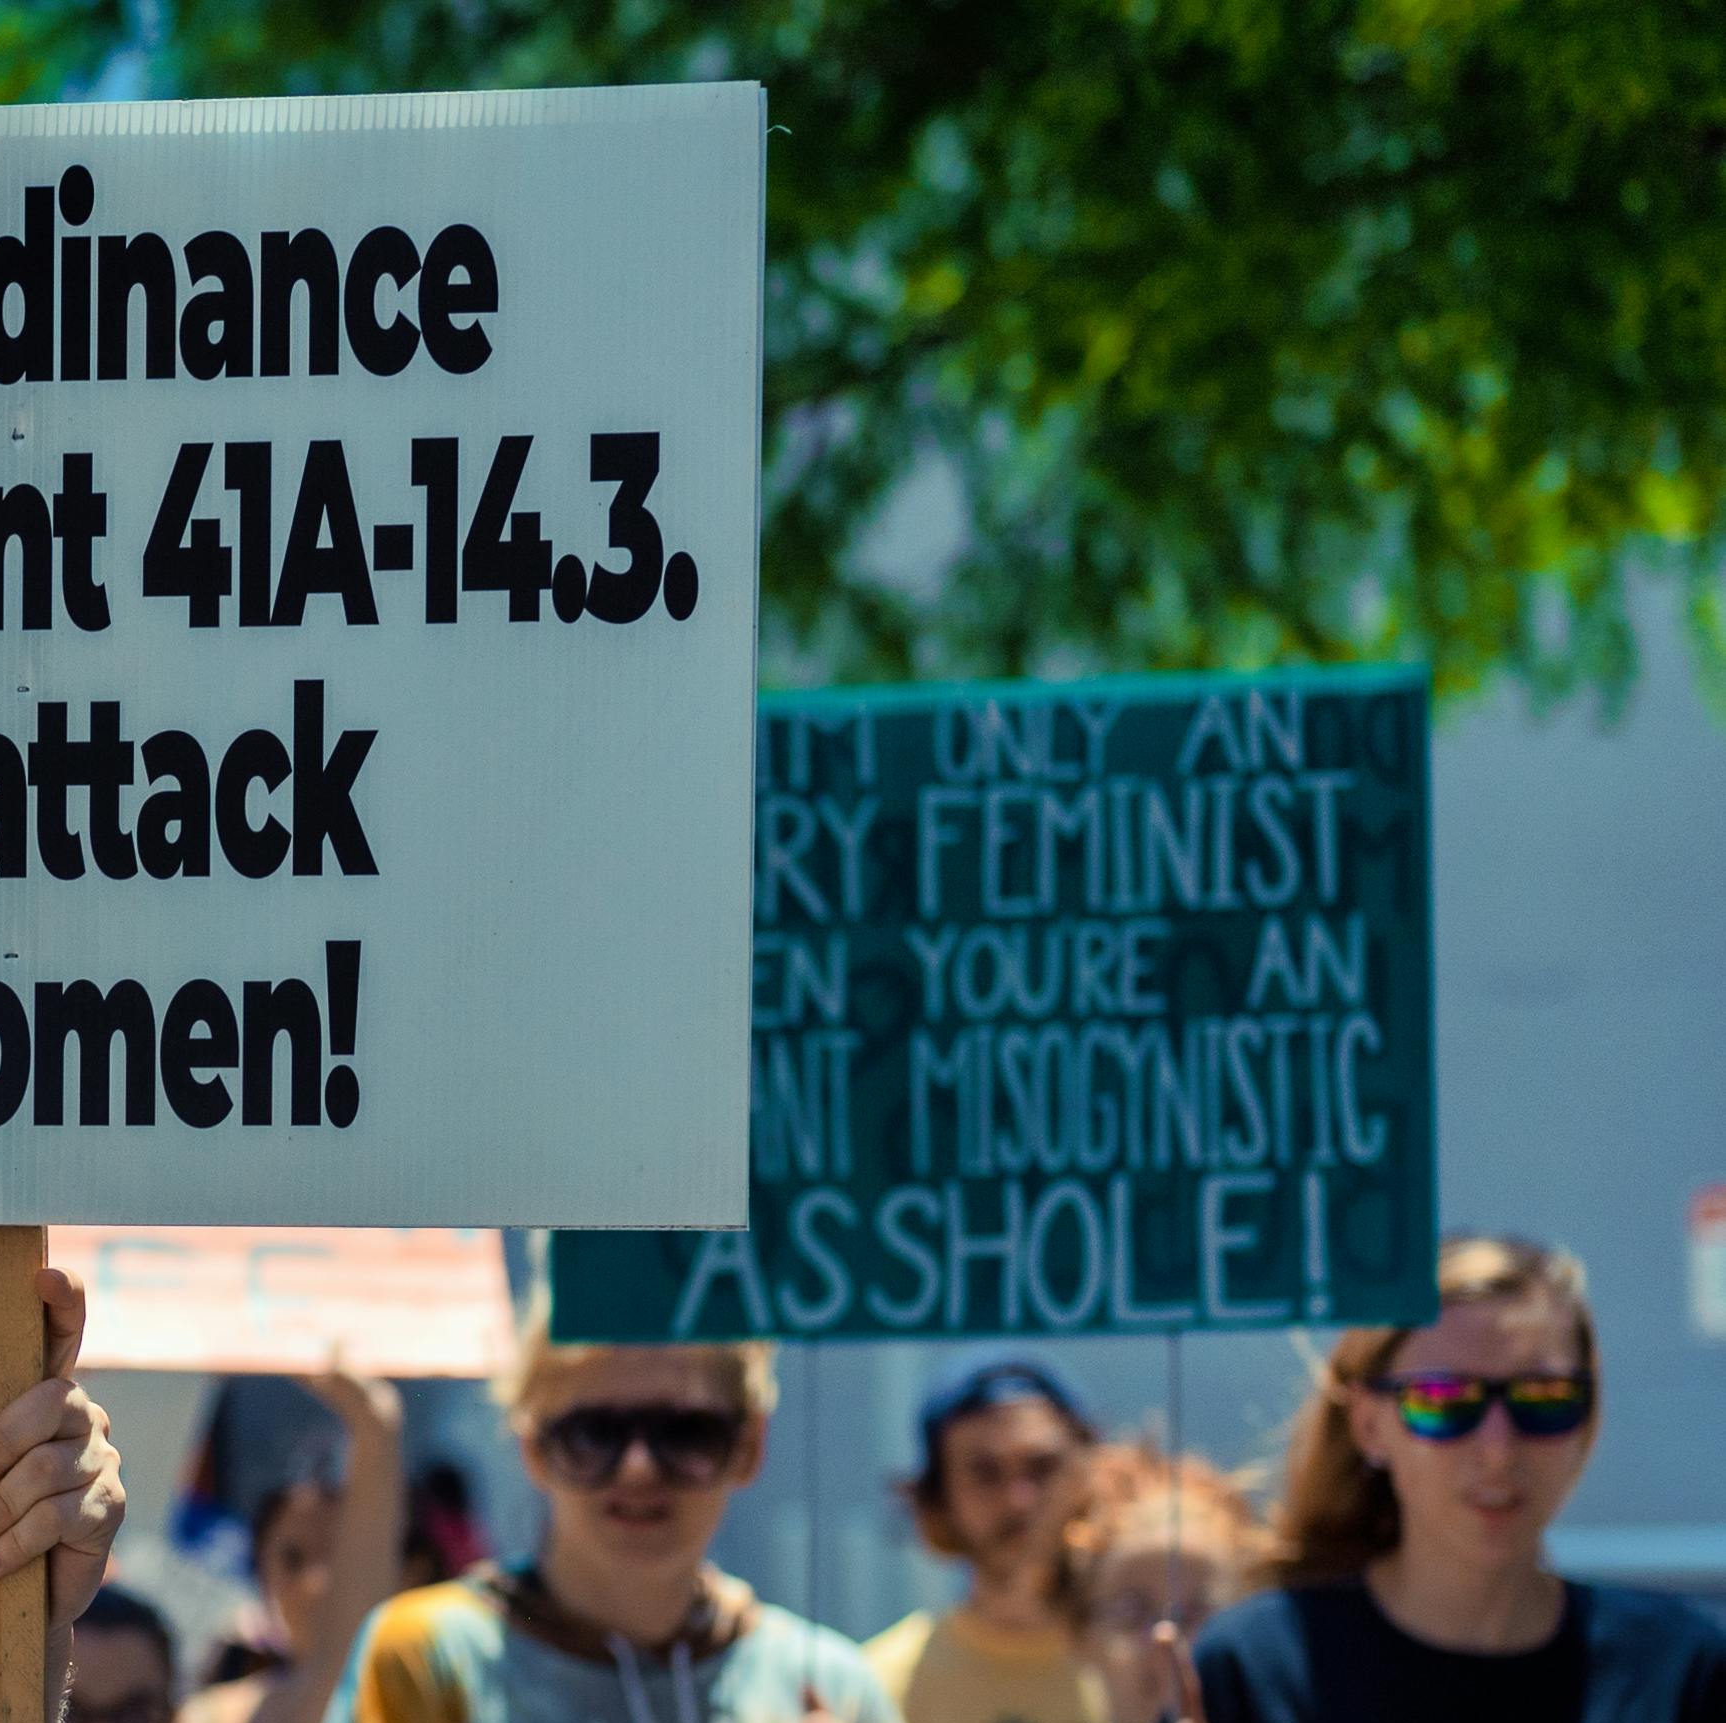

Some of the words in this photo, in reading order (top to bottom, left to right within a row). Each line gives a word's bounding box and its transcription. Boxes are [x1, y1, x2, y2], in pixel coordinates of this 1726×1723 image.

[143, 432, 698, 628] 41A-14.3.
[931, 694, 1128, 782] ONLY
[1175, 686, 1304, 775] AN
[917, 767, 1356, 922] FEMINIST
[1249, 910, 1367, 1006] AN
[909, 1010, 1389, 1177] MISOGYNISTIC
[671, 1170, 1333, 1340] ASSHOLE!
